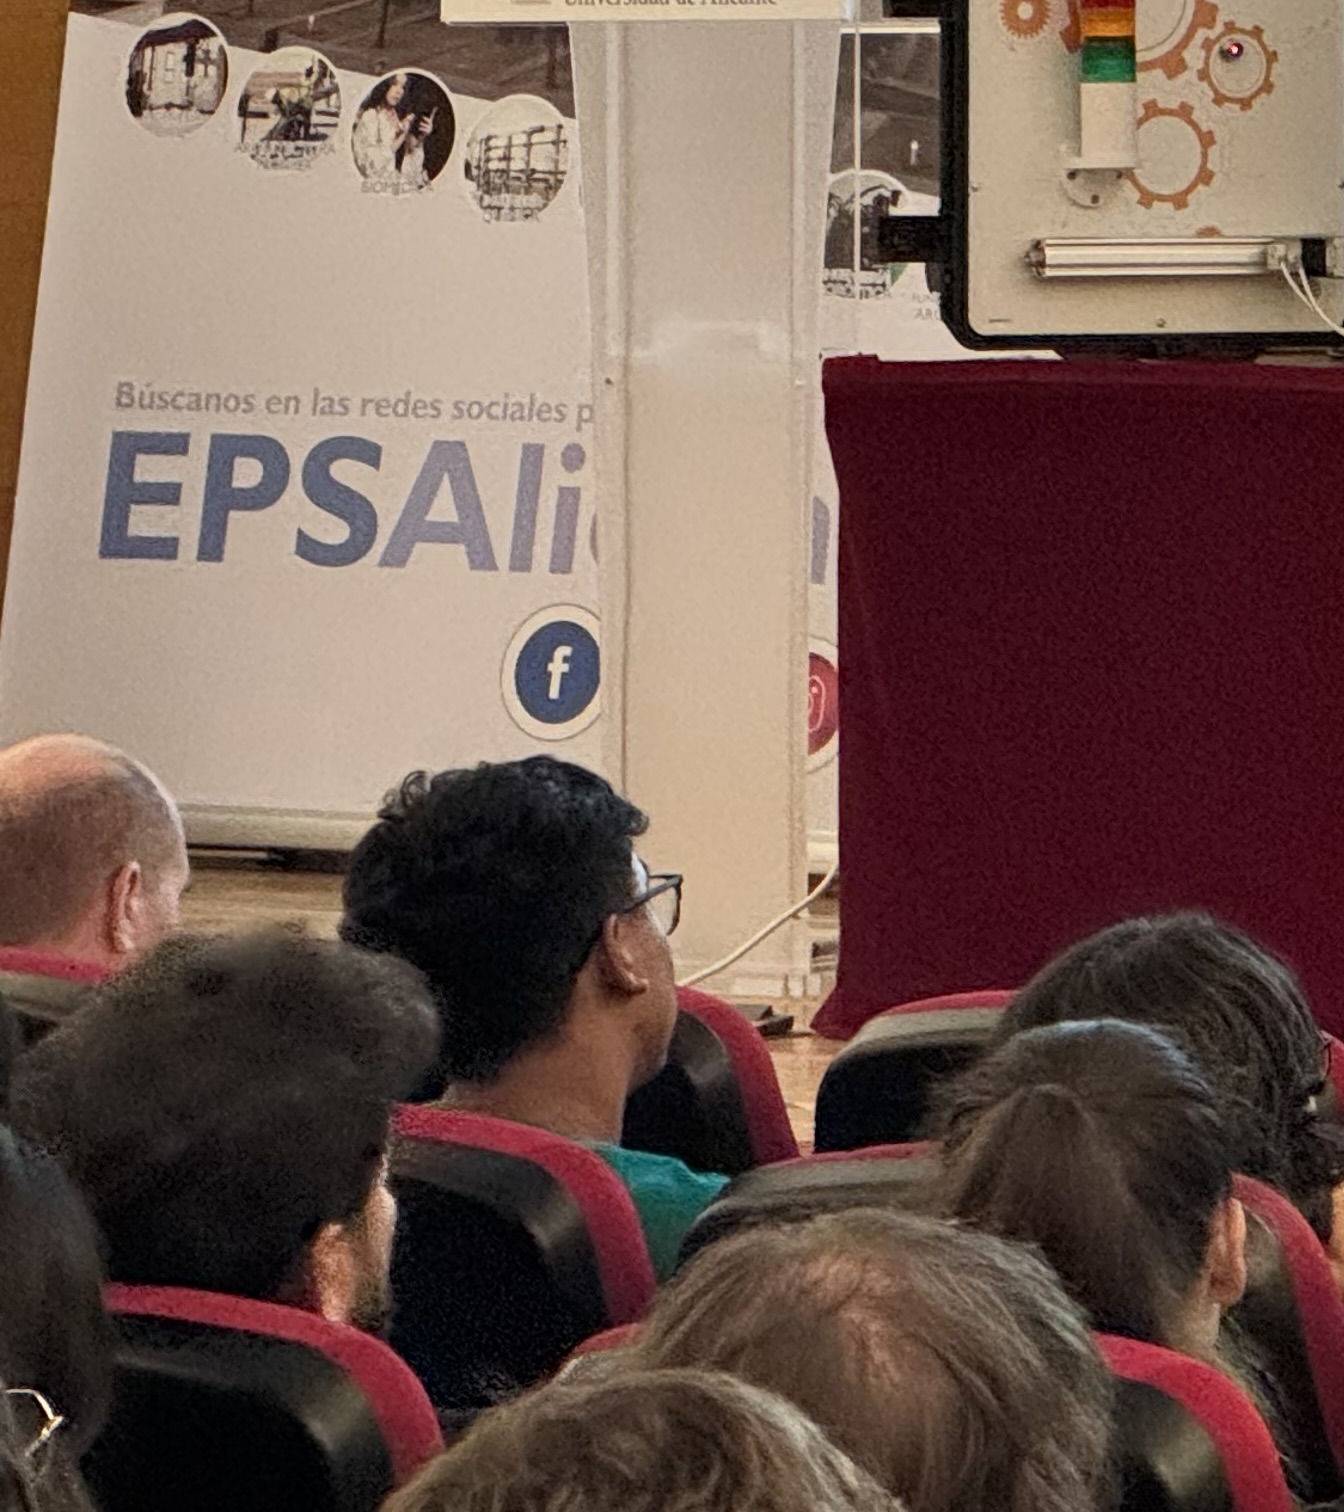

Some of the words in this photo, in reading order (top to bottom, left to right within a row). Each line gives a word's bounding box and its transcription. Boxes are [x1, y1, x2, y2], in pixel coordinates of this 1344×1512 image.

[115, 381, 256, 414] Búscanos
[264, 393, 301, 415] en
[311, 388, 350, 417] las
[359, 390, 443, 419] redes
[451, 392, 568, 423] sociales
[98, 429, 598, 575] EPSAli
